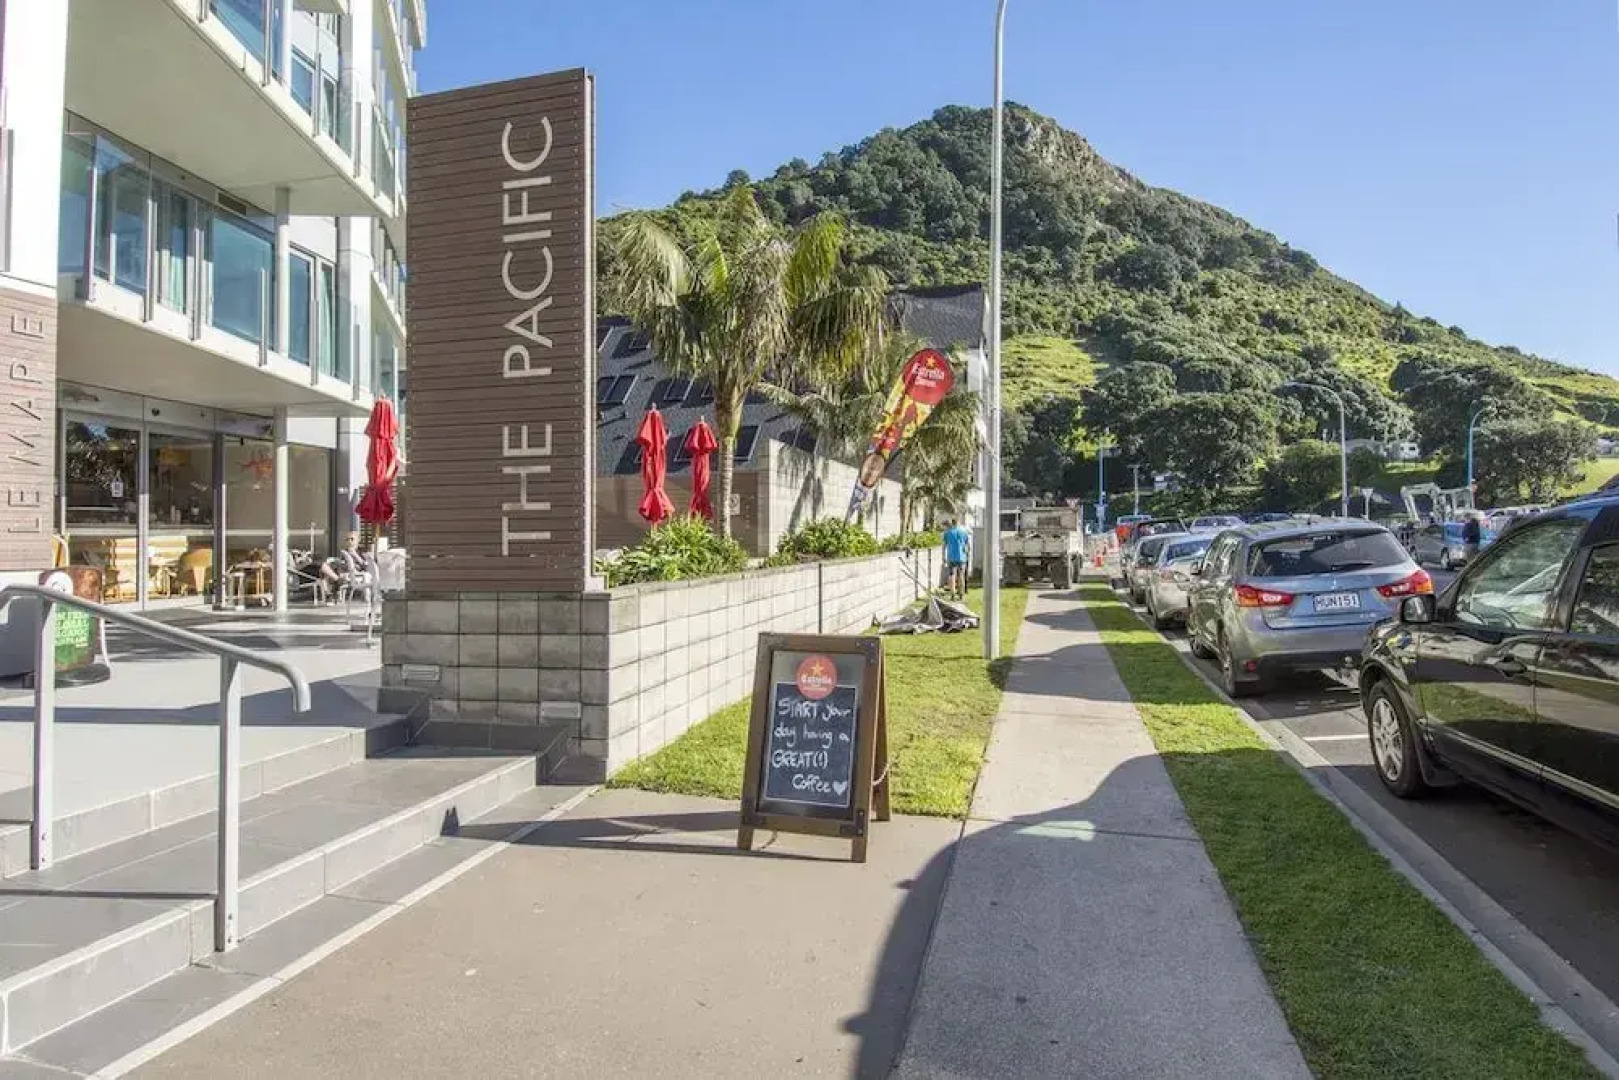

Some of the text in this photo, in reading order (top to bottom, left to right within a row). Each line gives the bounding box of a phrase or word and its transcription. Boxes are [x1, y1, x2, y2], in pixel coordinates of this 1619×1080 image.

[501, 116, 553, 556] THE PACIFIC
[778, 697, 818, 719] START
[774, 722, 850, 749] day having a
